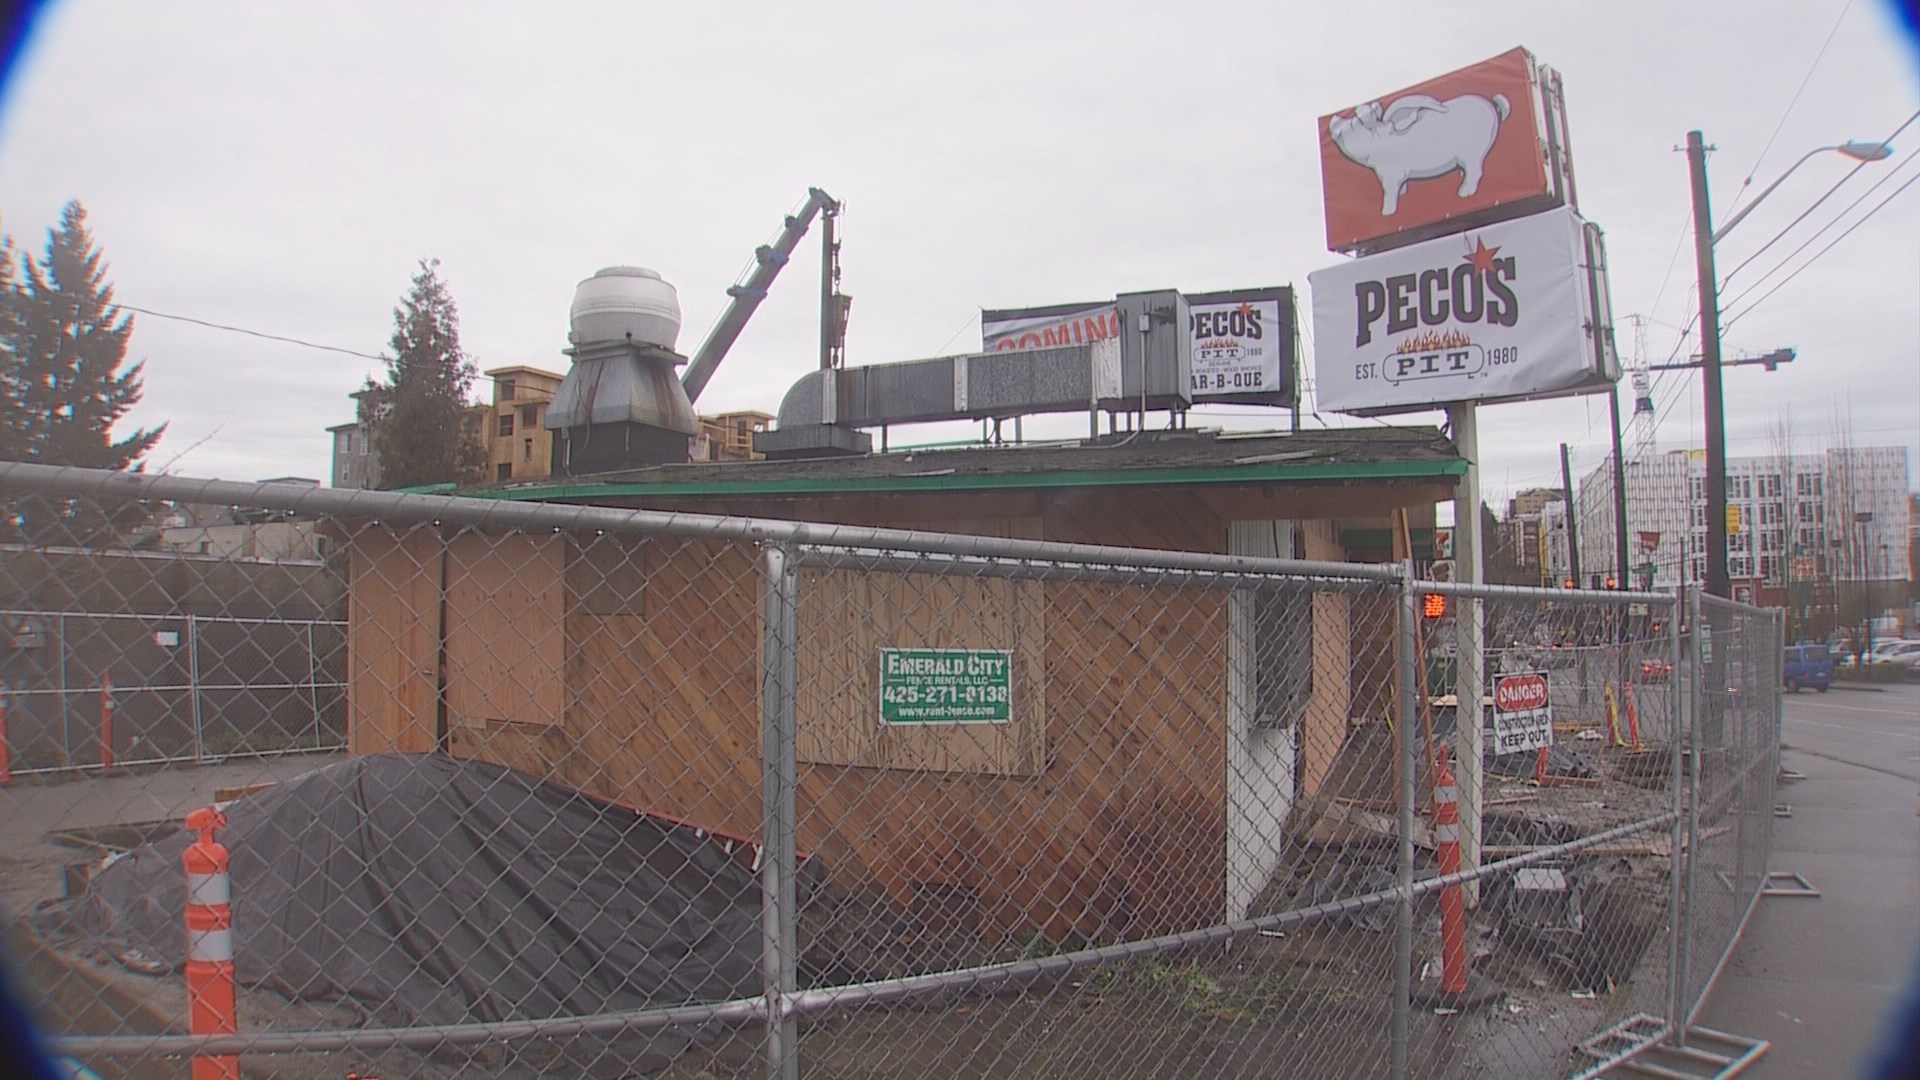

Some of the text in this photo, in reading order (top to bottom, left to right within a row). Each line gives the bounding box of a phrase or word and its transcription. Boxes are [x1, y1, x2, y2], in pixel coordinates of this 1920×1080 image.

[1201, 349, 1239, 359] PIT
[1356, 347, 1518, 380] EST. PIT 1980
[888, 654, 1003, 675] EMERALD CITY
[906, 676, 933, 685] FENCE
[973, 676, 989, 685] LLC
[884, 686, 1007, 703] 425-271-0138
[1500, 683, 1544, 703] DANGER
[898, 706, 995, 717] www.rent-fence.com
[1501, 729, 1546, 747] KEEP OUT
